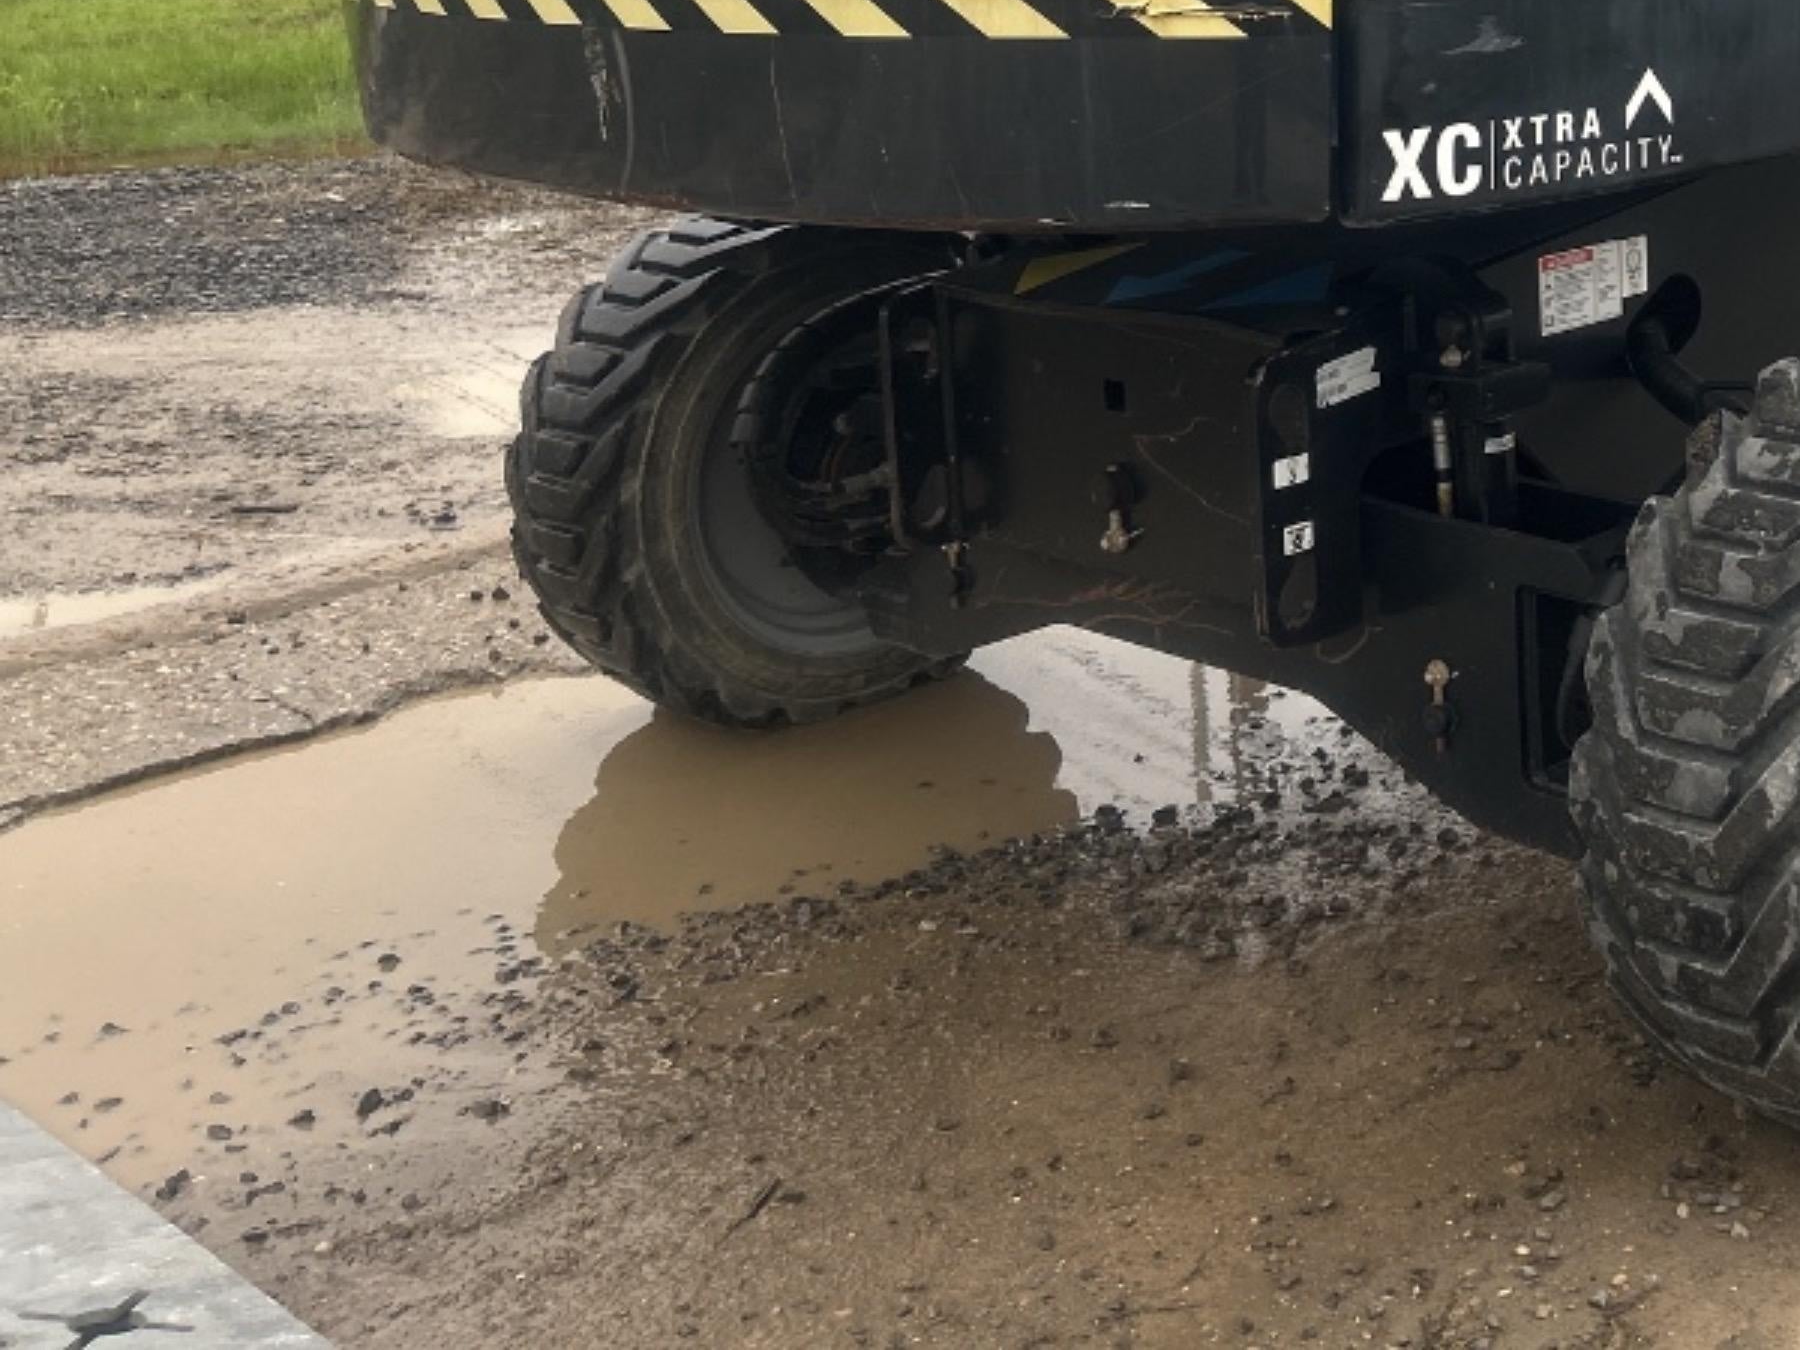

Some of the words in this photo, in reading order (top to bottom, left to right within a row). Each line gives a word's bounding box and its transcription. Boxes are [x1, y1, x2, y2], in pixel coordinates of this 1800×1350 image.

[1502, 107, 1601, 151] XTRA
[1380, 121, 1483, 202] XC
[1502, 134, 1673, 190] CAPACITY
